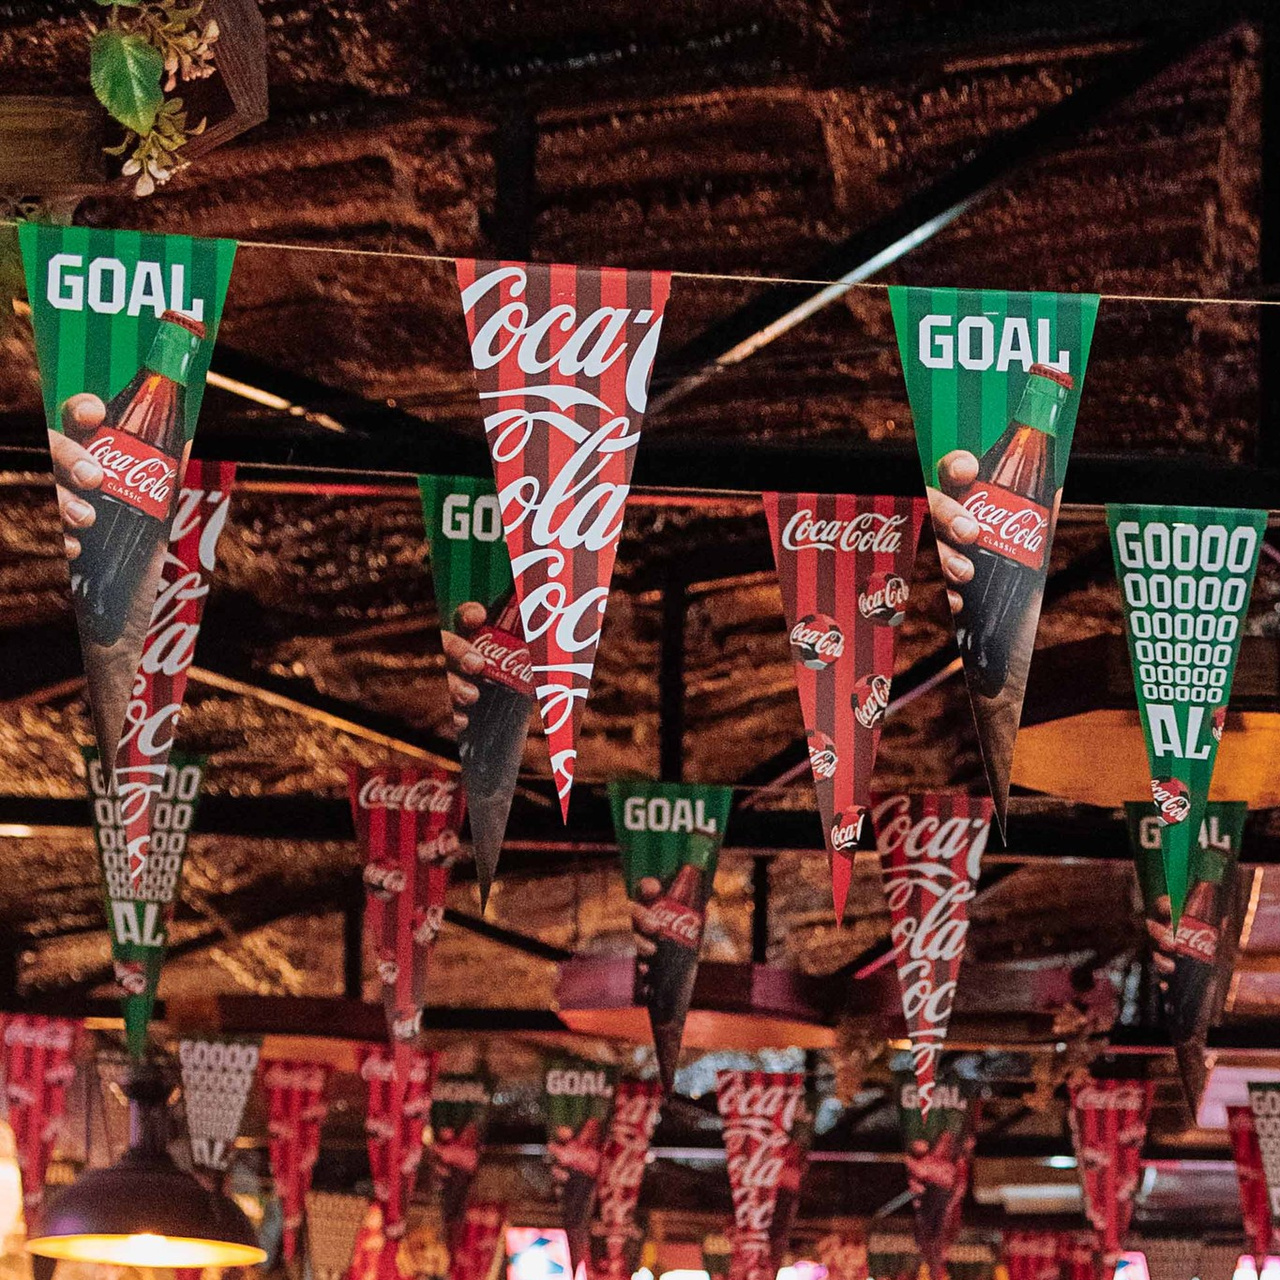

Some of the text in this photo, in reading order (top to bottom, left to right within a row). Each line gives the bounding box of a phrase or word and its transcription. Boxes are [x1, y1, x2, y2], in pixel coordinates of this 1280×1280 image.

[47, 253, 204, 322] GOAL
[919, 314, 1070, 374] GOAL
[107, 481, 142, 503] CLASSIC
[442, 494, 503, 542] GO
[782, 508, 908, 554] Coca-Cola
[961, 491, 1048, 557] Coca-Cola
[982, 534, 1017, 556] CLASSIC
[1116, 520, 1259, 574] GOOOO
[1123, 572, 1251, 613] OOOOO
[1130, 610, 1238, 645] OOOOO
[1135, 640, 1233, 668] OOOOO
[1139, 664, 1227, 688] OOOOO
[1142, 683, 1223, 704] OOOOO
[1145, 704, 1212, 761] AL
[358, 775, 459, 813] Coca-Cola
[624, 797, 717, 834] GOAL
[1140, 816, 1231, 851] GAL
[111, 900, 165, 947] AL
